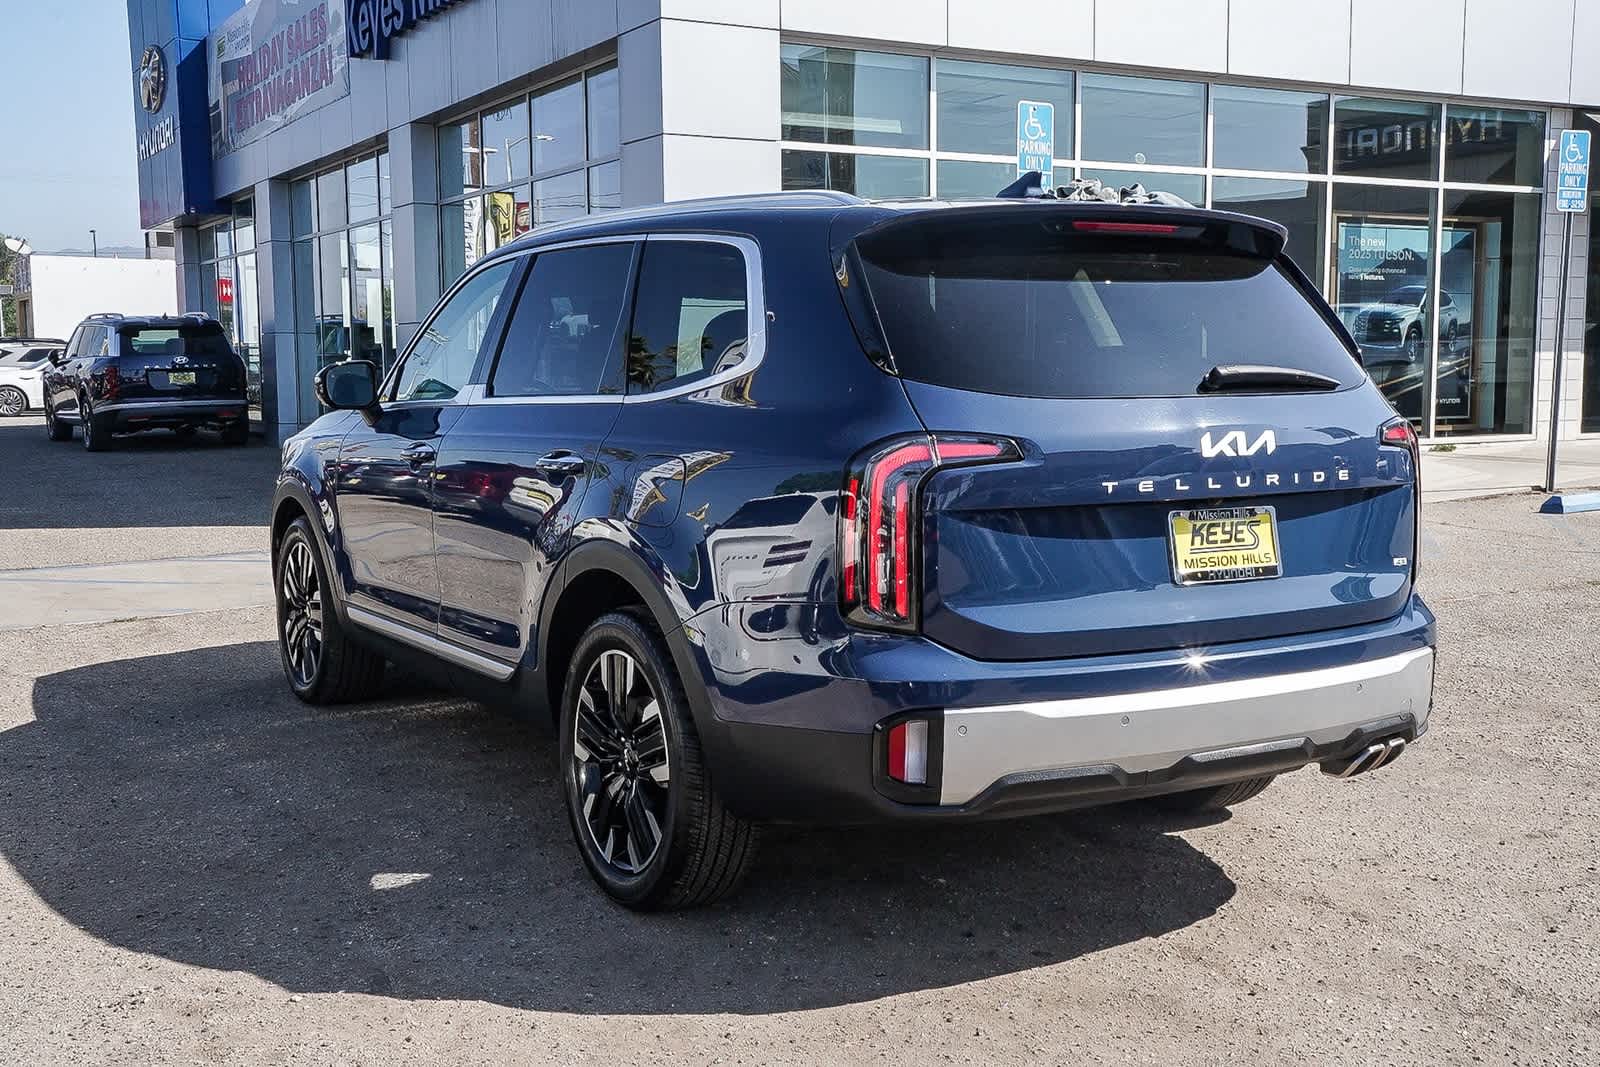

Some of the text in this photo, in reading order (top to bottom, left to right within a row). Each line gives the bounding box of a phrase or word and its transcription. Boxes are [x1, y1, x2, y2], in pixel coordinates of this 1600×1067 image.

[345, 0, 404, 59] Keyes
[238, 31, 284, 92] HOLIDAY
[286, 3, 327, 64] SALES
[139, 115, 174, 160] HYUNDAI
[1020, 140, 1051, 155] PARKING
[1025, 156, 1045, 169] ONLY
[1561, 163, 1587, 174] PARKING
[1564, 175, 1582, 187] ONLY
[1349, 236, 1385, 247] The new
[1348, 248, 1415, 261] 2025 TUCSON.
[1200, 430, 1277, 458] KIA
[1102, 469, 1350, 495] TELLURIDE
[1197, 508, 1250, 521] Mission Hills
[1190, 519, 1261, 555] KEYES
[1184, 552, 1272, 569] MISSION HILLS
